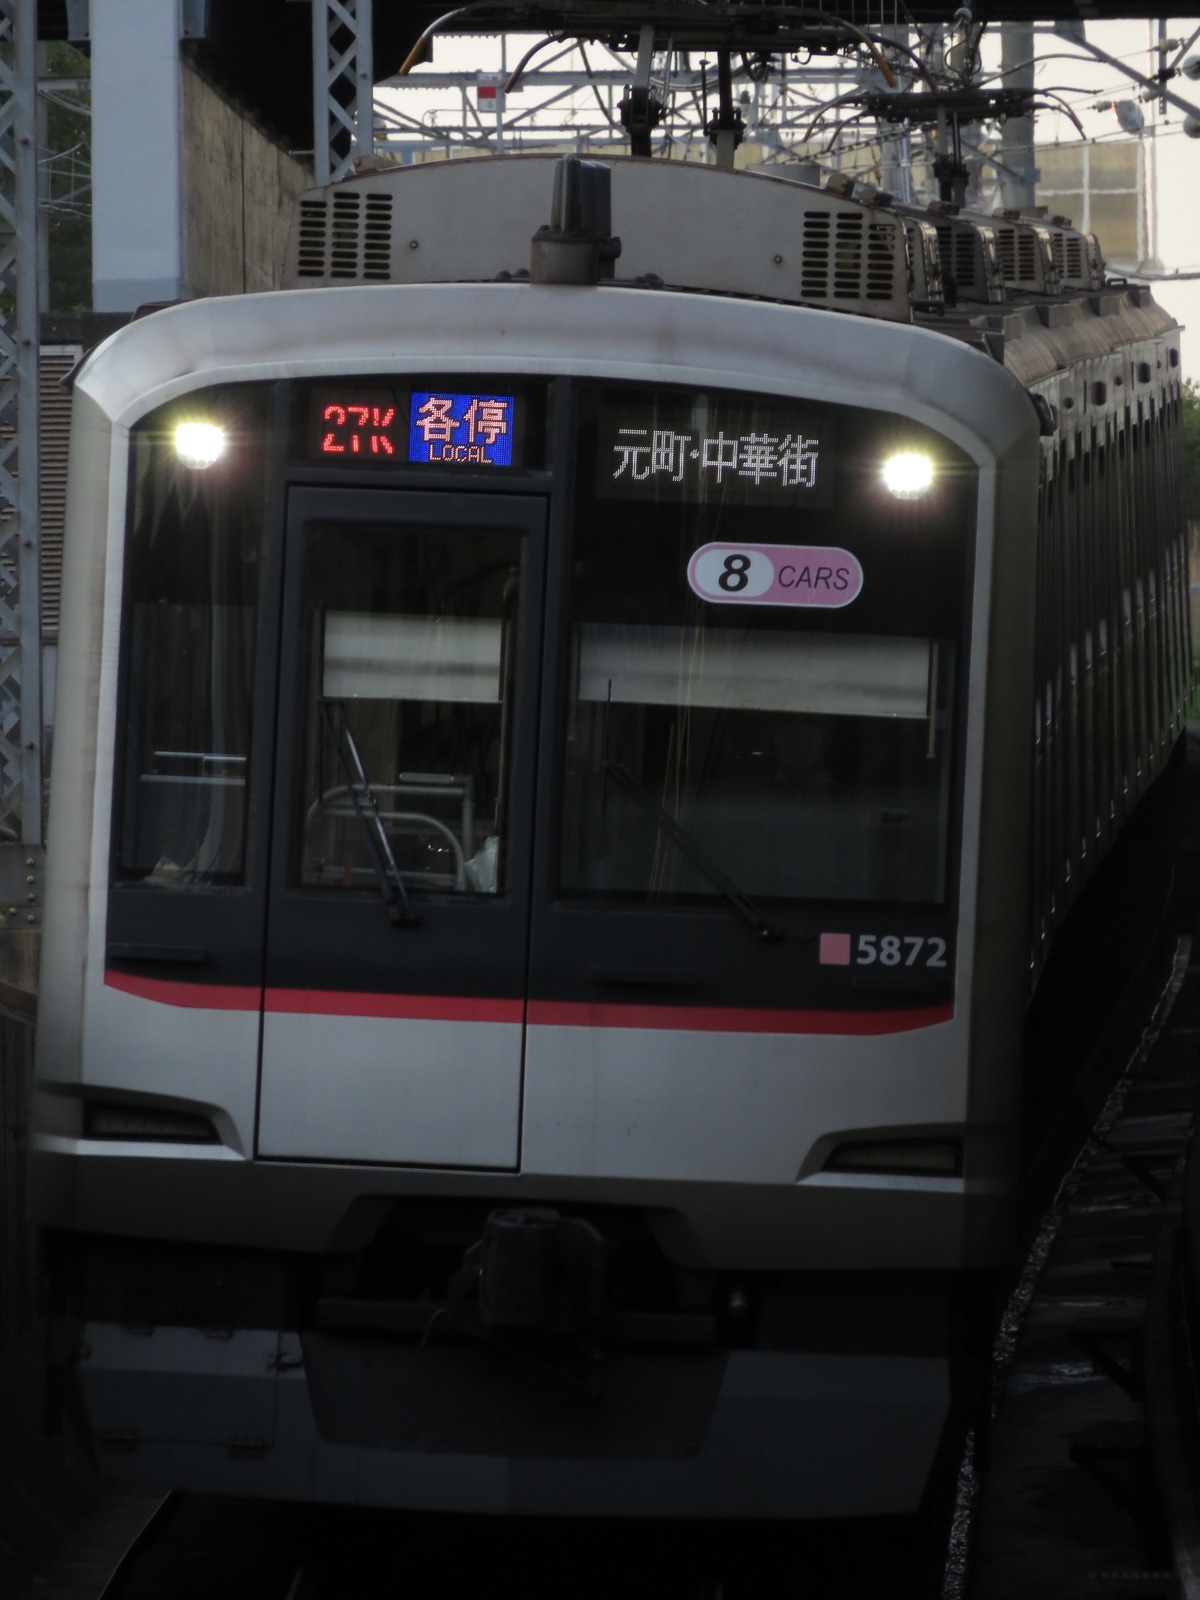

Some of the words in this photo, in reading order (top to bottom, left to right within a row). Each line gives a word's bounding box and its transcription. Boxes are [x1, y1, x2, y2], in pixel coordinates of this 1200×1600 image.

[415, 397, 508, 444] 各停
[429, 444, 492, 464] LOCAL
[718, 554, 751, 592] 8
[778, 565, 850, 590] CARS
[856, 934, 947, 967] 5872
